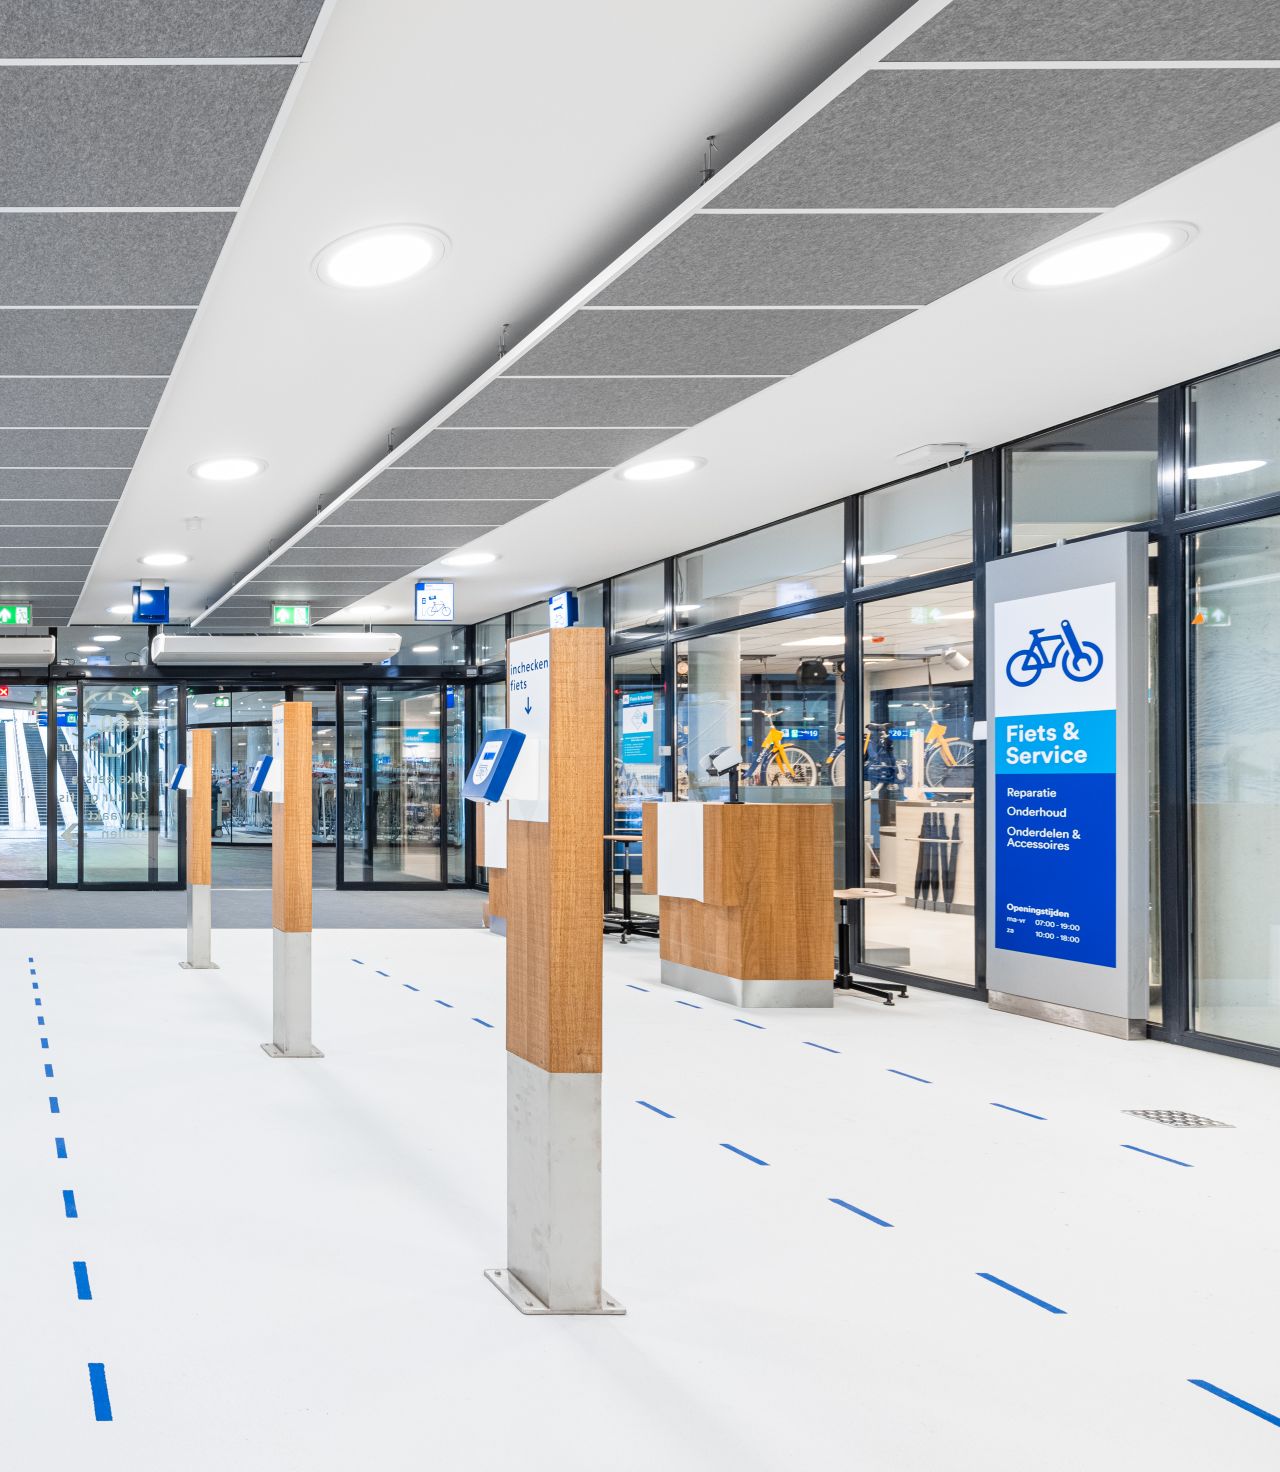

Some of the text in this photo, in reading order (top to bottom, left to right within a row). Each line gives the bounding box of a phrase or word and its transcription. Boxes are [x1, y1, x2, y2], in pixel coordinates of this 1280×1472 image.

[510, 658, 549, 675] inchecken
[510, 680, 528, 692] fiets
[1006, 721, 1080, 743] Fiets &
[1006, 744, 1088, 765] Service
[1007, 787, 1057, 799] Reparatie
[1006, 806, 1067, 818] Onderhoud
[1006, 826, 1081, 840] Onderdelen &
[1006, 837, 1070, 851] Accessoires
[1006, 903, 1070, 918] Openingstijden
[1034, 919, 1055, 928] 07:00
[1060, 922, 1080, 932] 19:00
[1035, 931, 1055, 940] 10:00
[1060, 934, 1080, 944] 18:00
